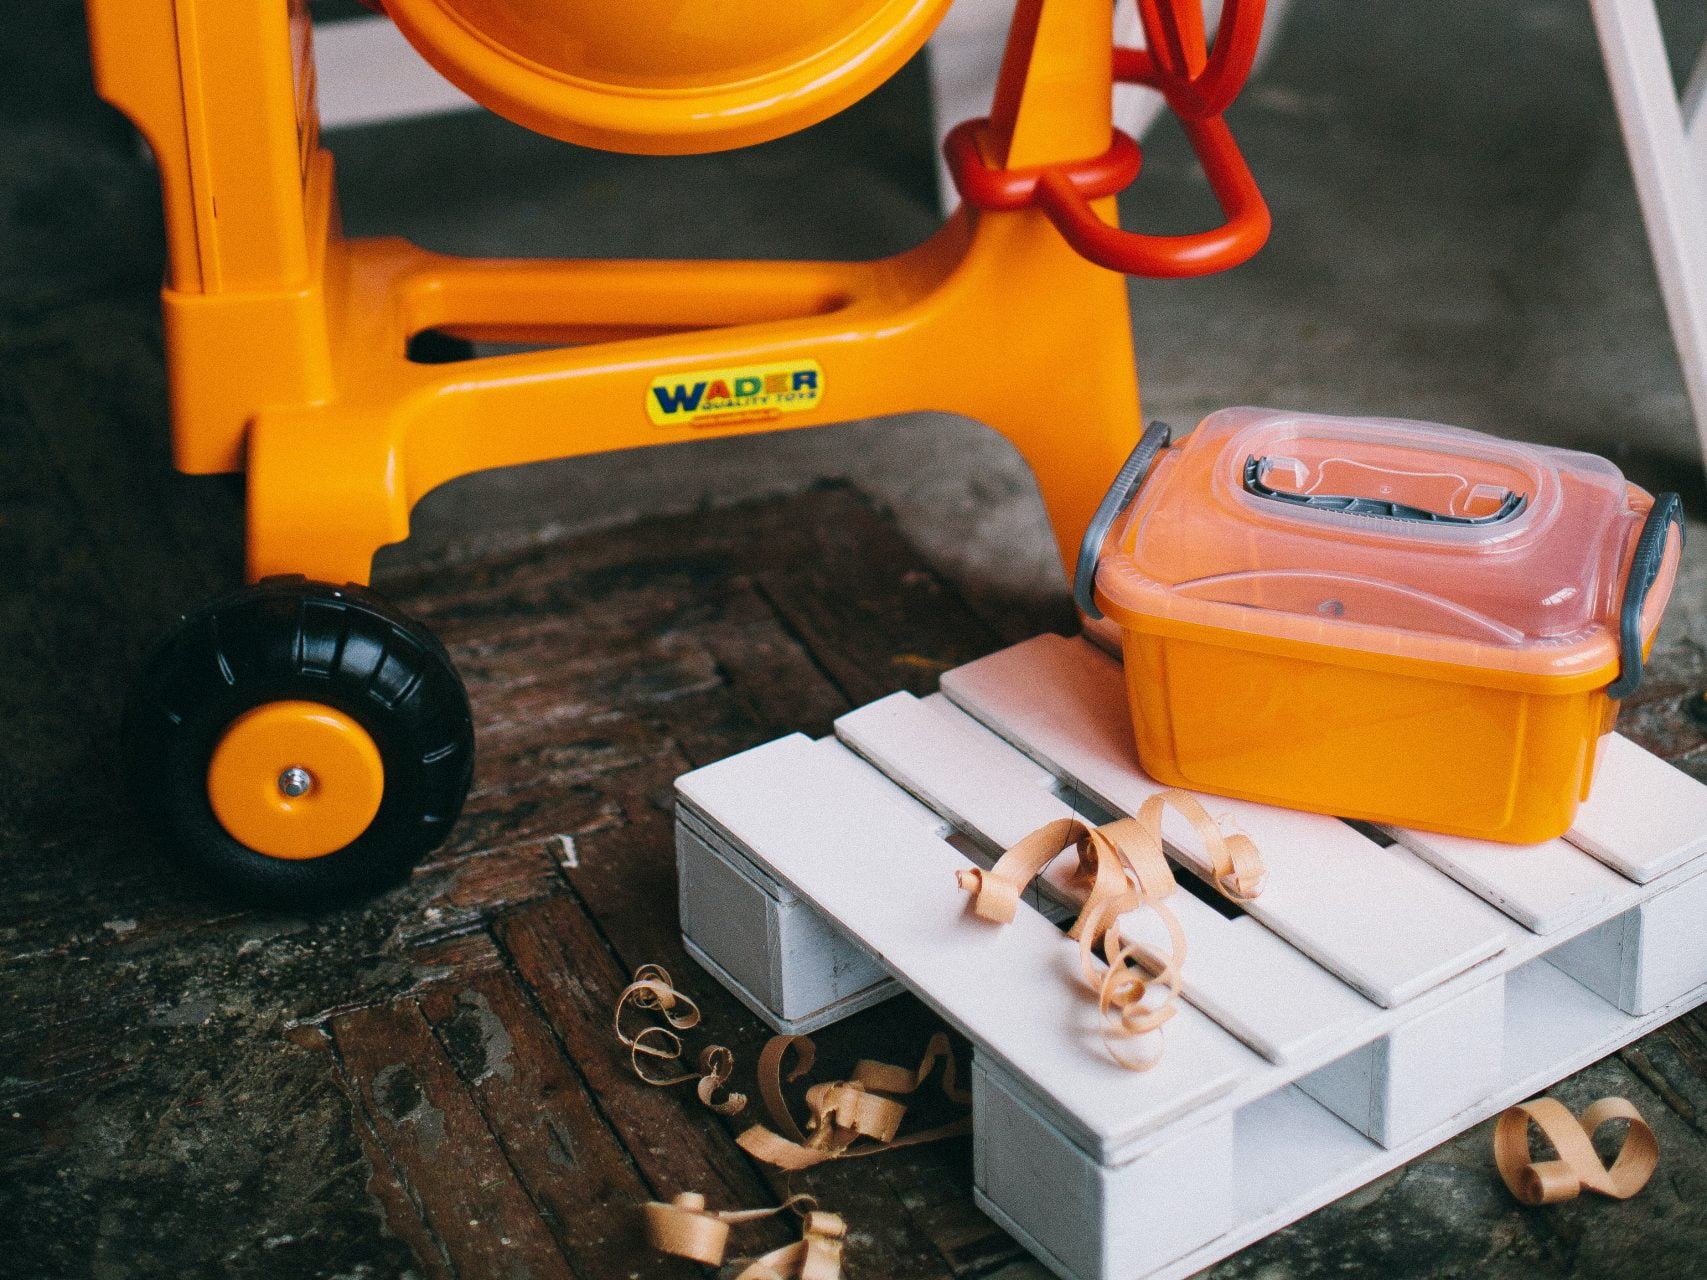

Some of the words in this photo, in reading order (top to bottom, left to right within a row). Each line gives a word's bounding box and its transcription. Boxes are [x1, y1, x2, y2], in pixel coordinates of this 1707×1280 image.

[653, 370, 818, 414] WADER
[702, 395, 768, 411] QUALITY
[777, 390, 817, 401] TOYS
